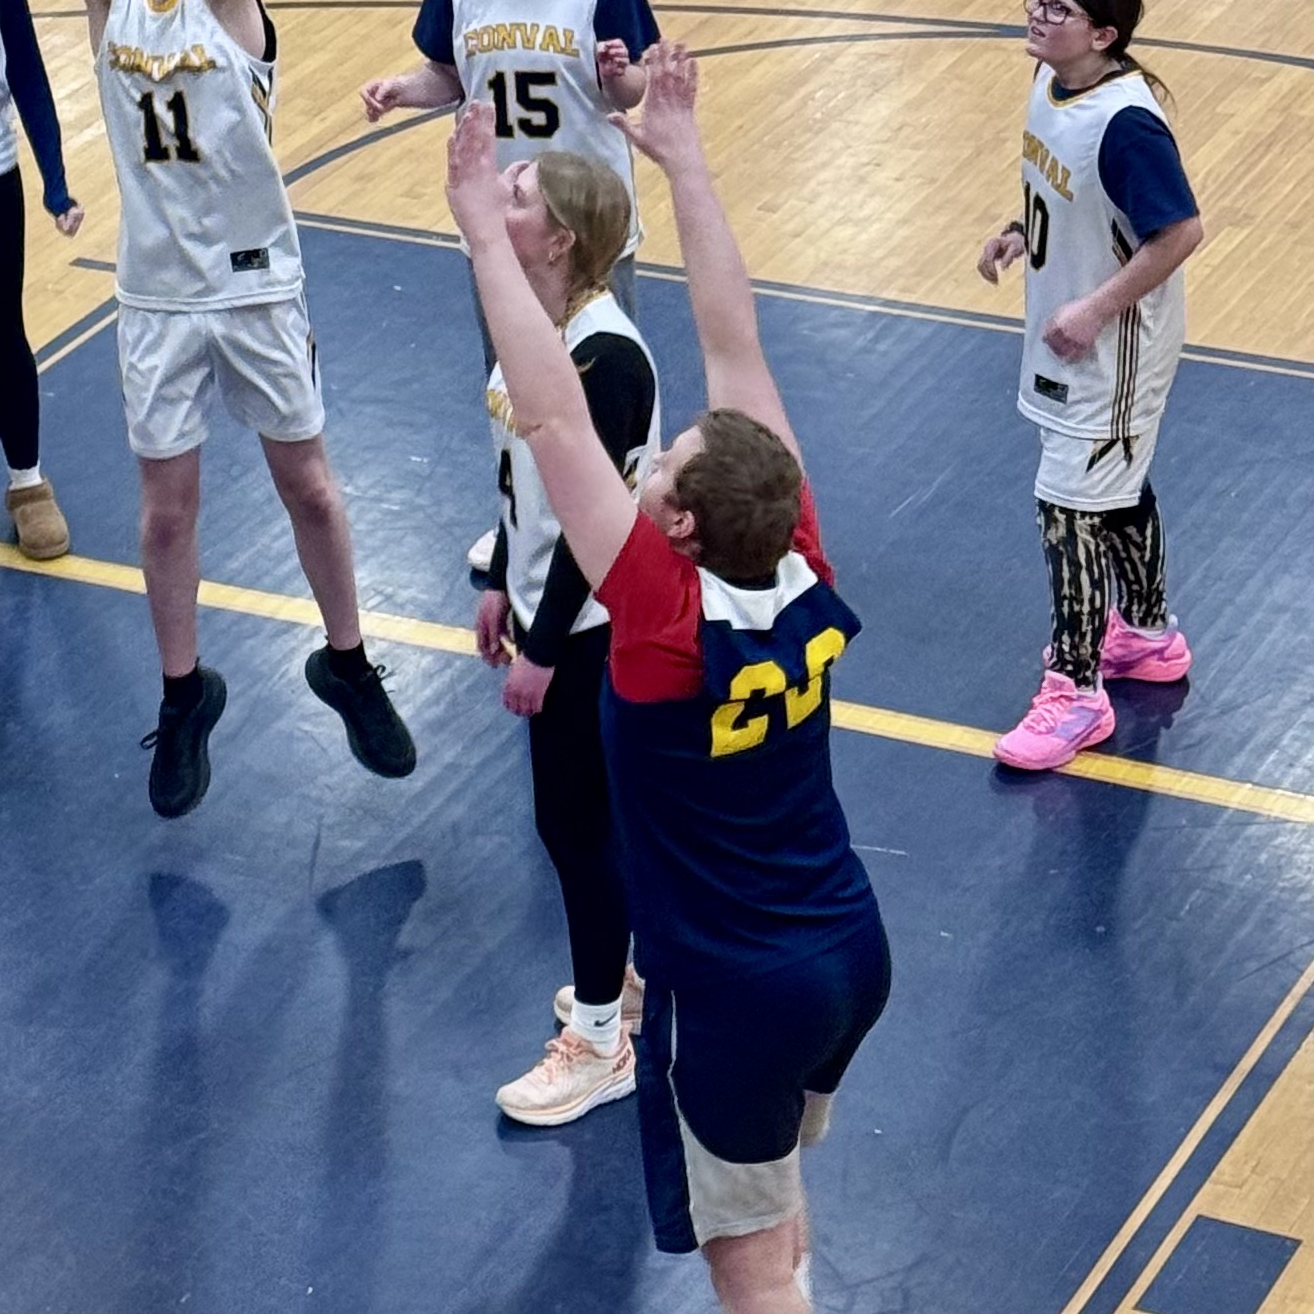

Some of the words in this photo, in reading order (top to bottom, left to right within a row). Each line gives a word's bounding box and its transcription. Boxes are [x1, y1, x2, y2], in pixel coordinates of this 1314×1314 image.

[464, 22, 580, 58] CONVAL
[137, 90, 202, 162] 11
[487, 70, 561, 140] 15
